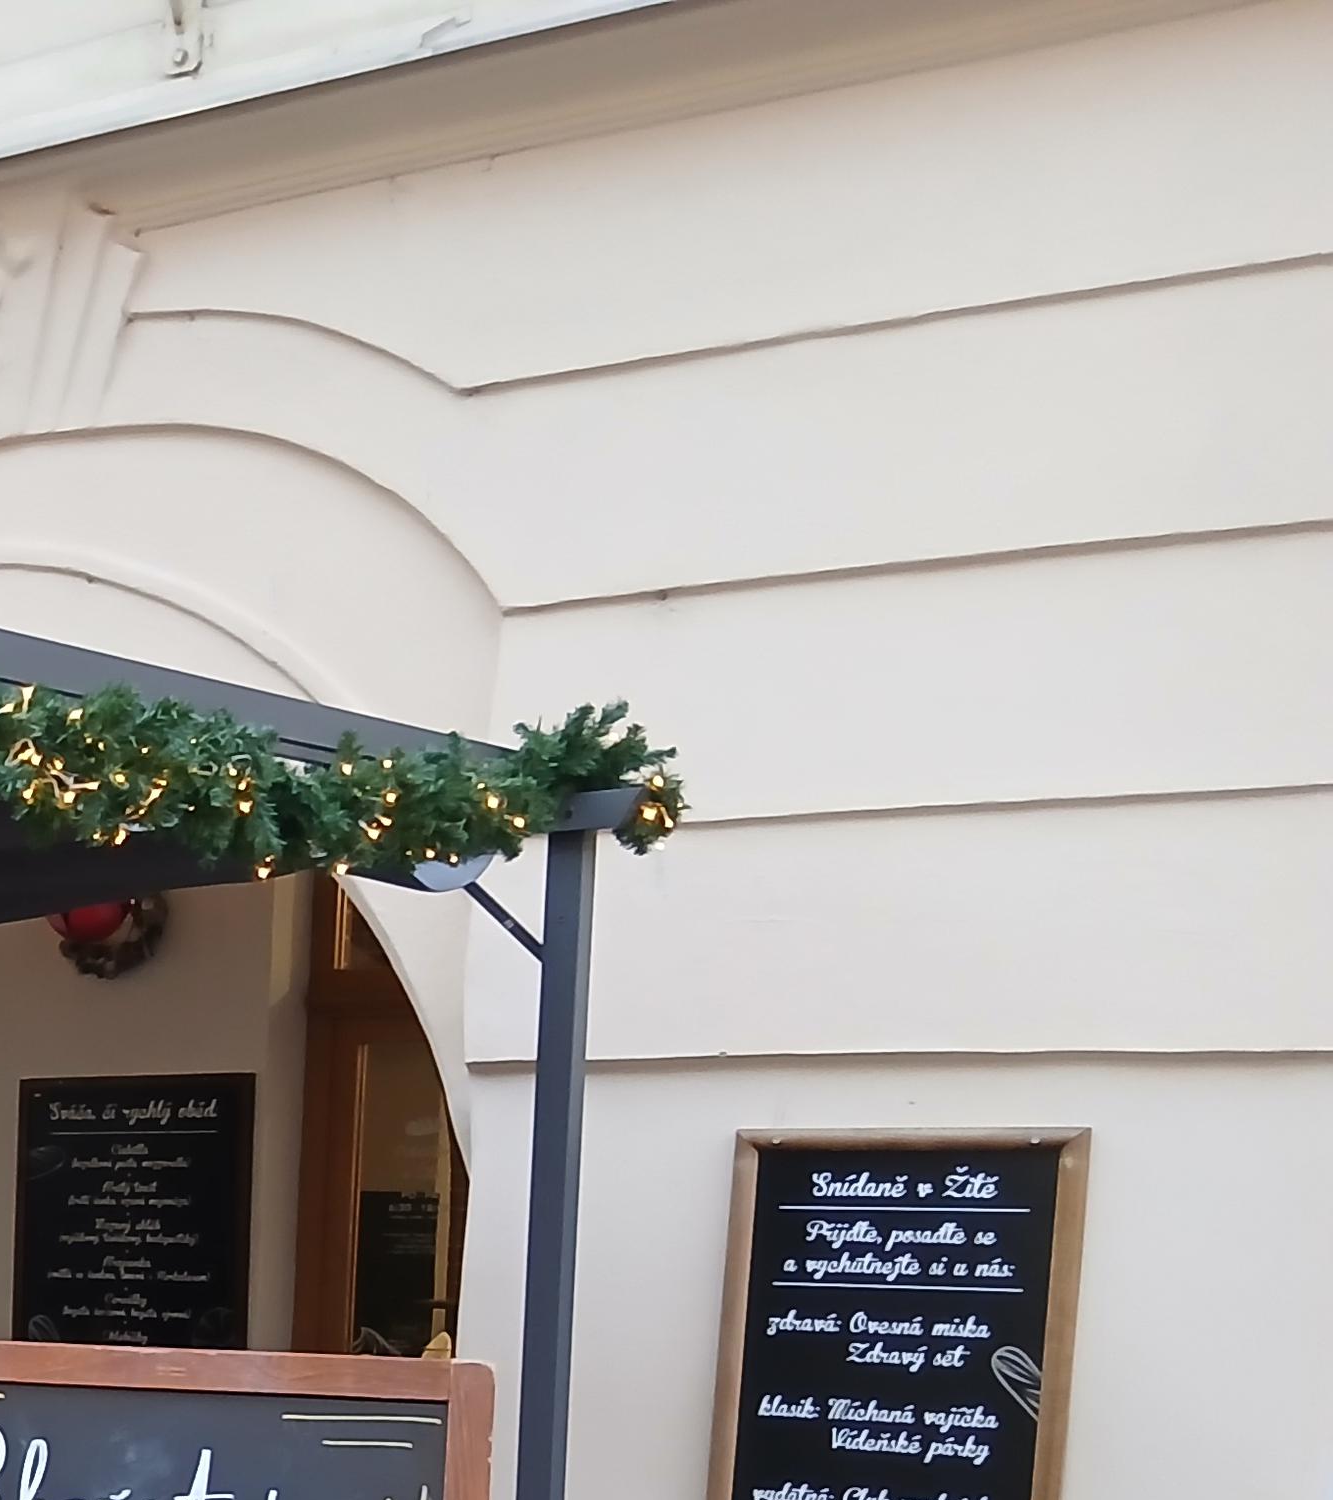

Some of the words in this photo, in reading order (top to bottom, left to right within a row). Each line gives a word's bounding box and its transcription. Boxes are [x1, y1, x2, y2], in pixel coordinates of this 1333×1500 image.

[812, 1172, 908, 1197] Snídaně
[917, 1183, 933, 1197] v
[942, 1166, 999, 1198] Žitě
[805, 1220, 882, 1248] Přijďte,
[884, 1223, 966, 1251] posaďte
[974, 1231, 997, 1245] se
[783, 1259, 797, 1272] a
[806, 1252, 921, 1281] vychutnejte
[929, 1257, 947, 1276] si
[953, 1263, 968, 1276] u
[975, 1258, 1016, 1277] nás:
[767, 1309, 842, 1335] zdravá:
[850, 1312, 923, 1336] Ovesná
[932, 1316, 991, 1338] miska
[846, 1342, 928, 1372] Zdravý
[933, 1345, 971, 1367] set
[757, 1395, 821, 1419] klasik:
[828, 1398, 915, 1423] Míchaná
[924, 1406, 999, 1433] vajíčka
[832, 1427, 922, 1454] Vídeňské
[923, 1435, 990, 1465] párky
